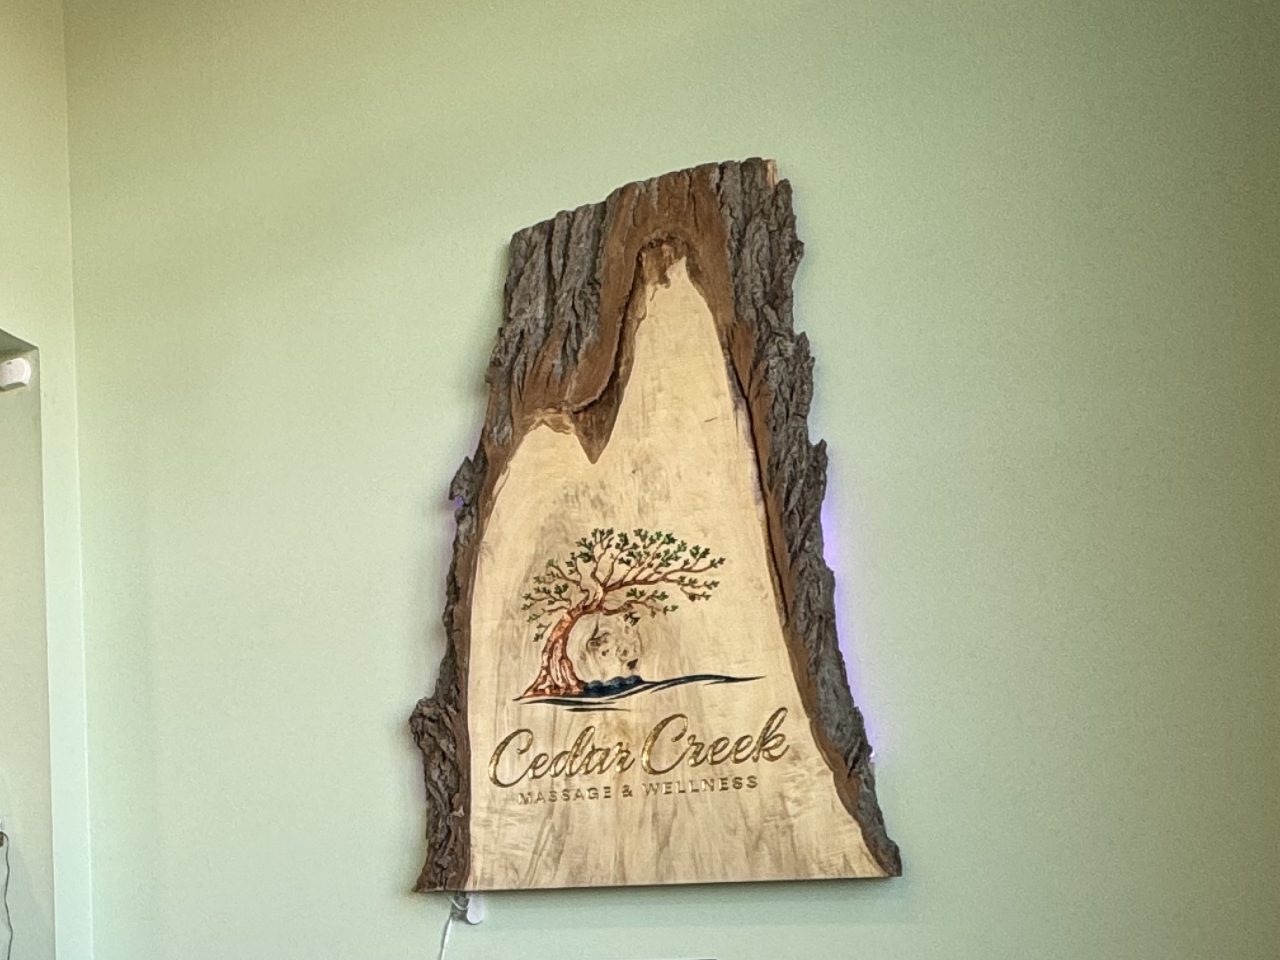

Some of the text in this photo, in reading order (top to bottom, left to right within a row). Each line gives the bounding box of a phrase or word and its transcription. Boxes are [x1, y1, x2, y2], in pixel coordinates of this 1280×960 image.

[488, 706, 791, 789] Cedar Creek
[517, 775, 759, 806] MASSAGE & WELLNESS
